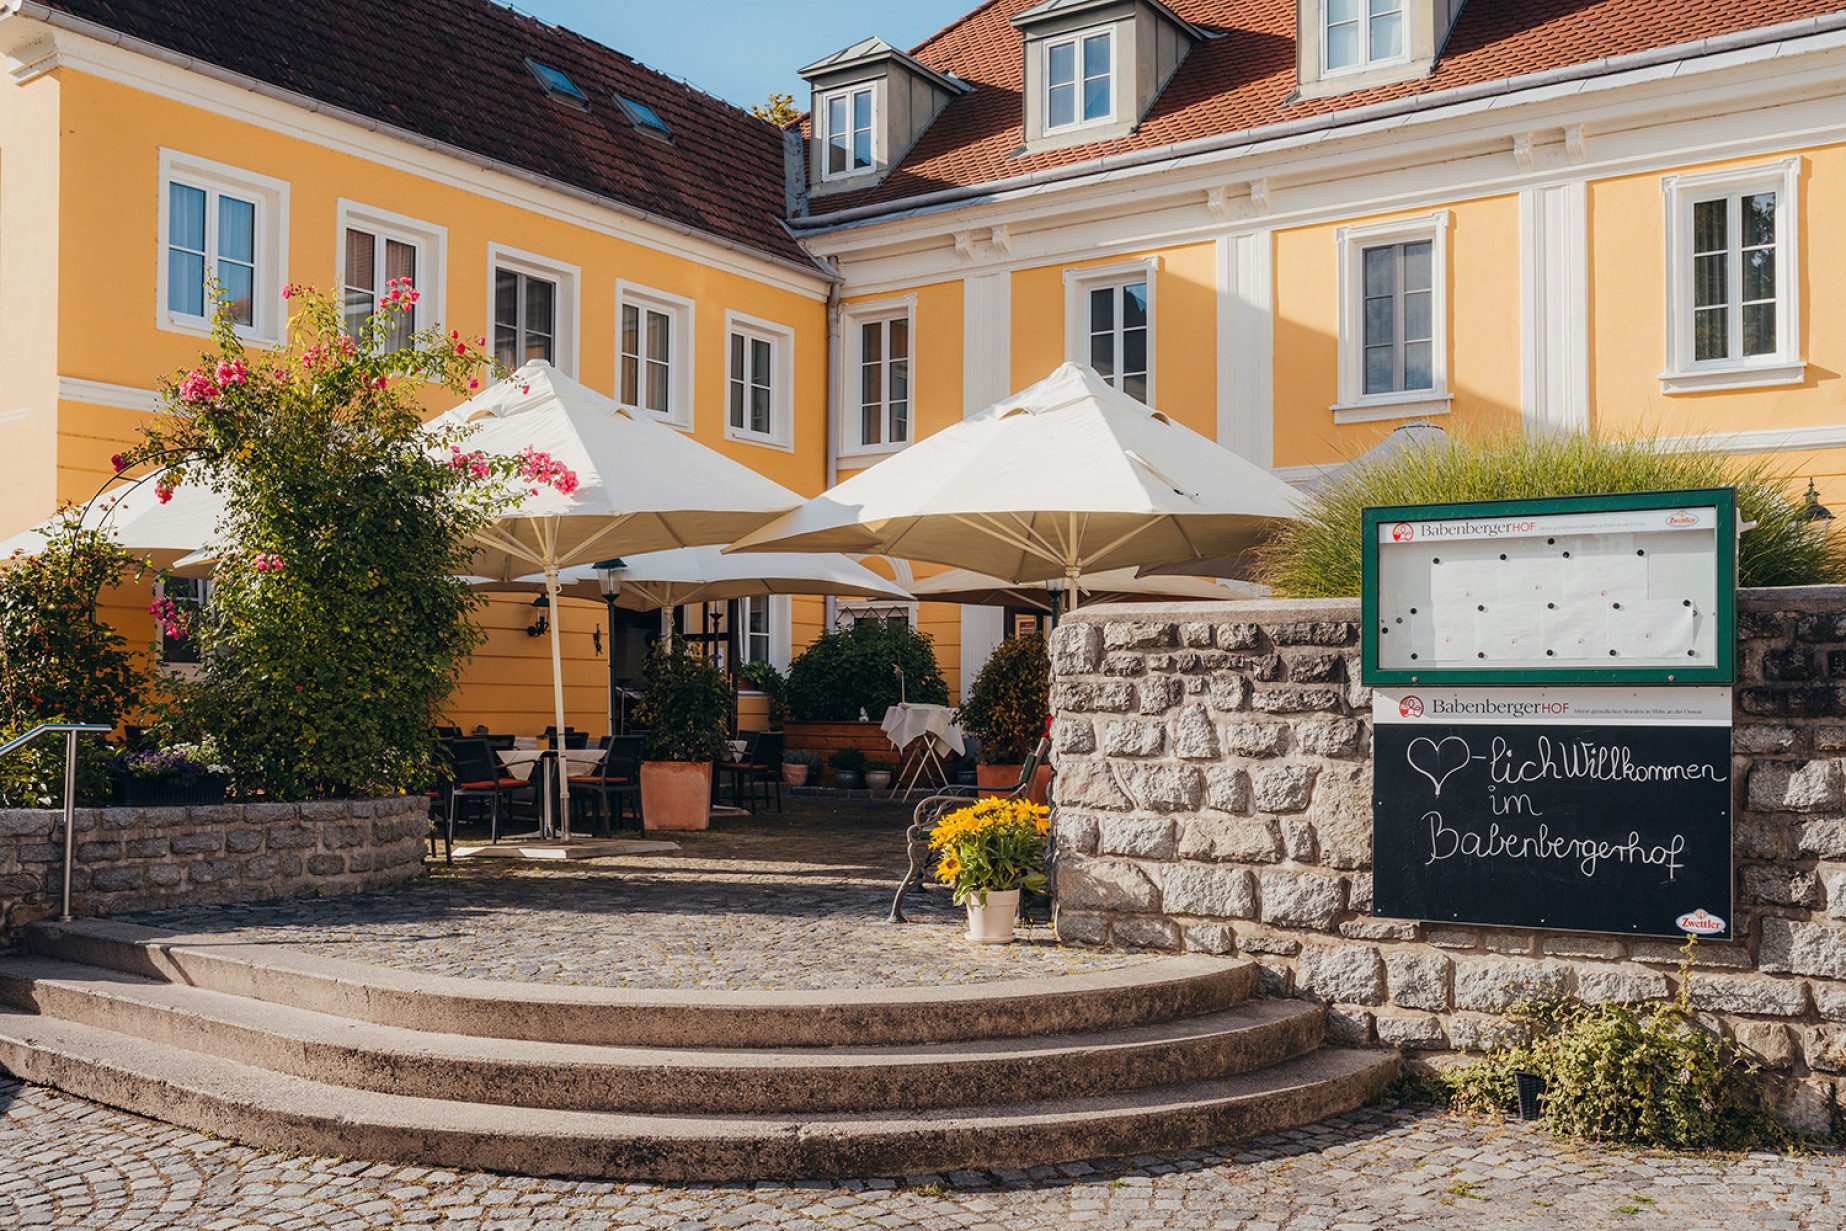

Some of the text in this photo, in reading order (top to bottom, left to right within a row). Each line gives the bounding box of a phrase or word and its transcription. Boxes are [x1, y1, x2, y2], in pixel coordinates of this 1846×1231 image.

[1420, 521, 1537, 537] BabenbergerHOF
[1432, 698, 1570, 718] BabenbergerHOF
[1487, 784, 1543, 817] im
[1420, 810, 1686, 880] Babenbergerhof
[1681, 916, 1721, 929] Zwettler
